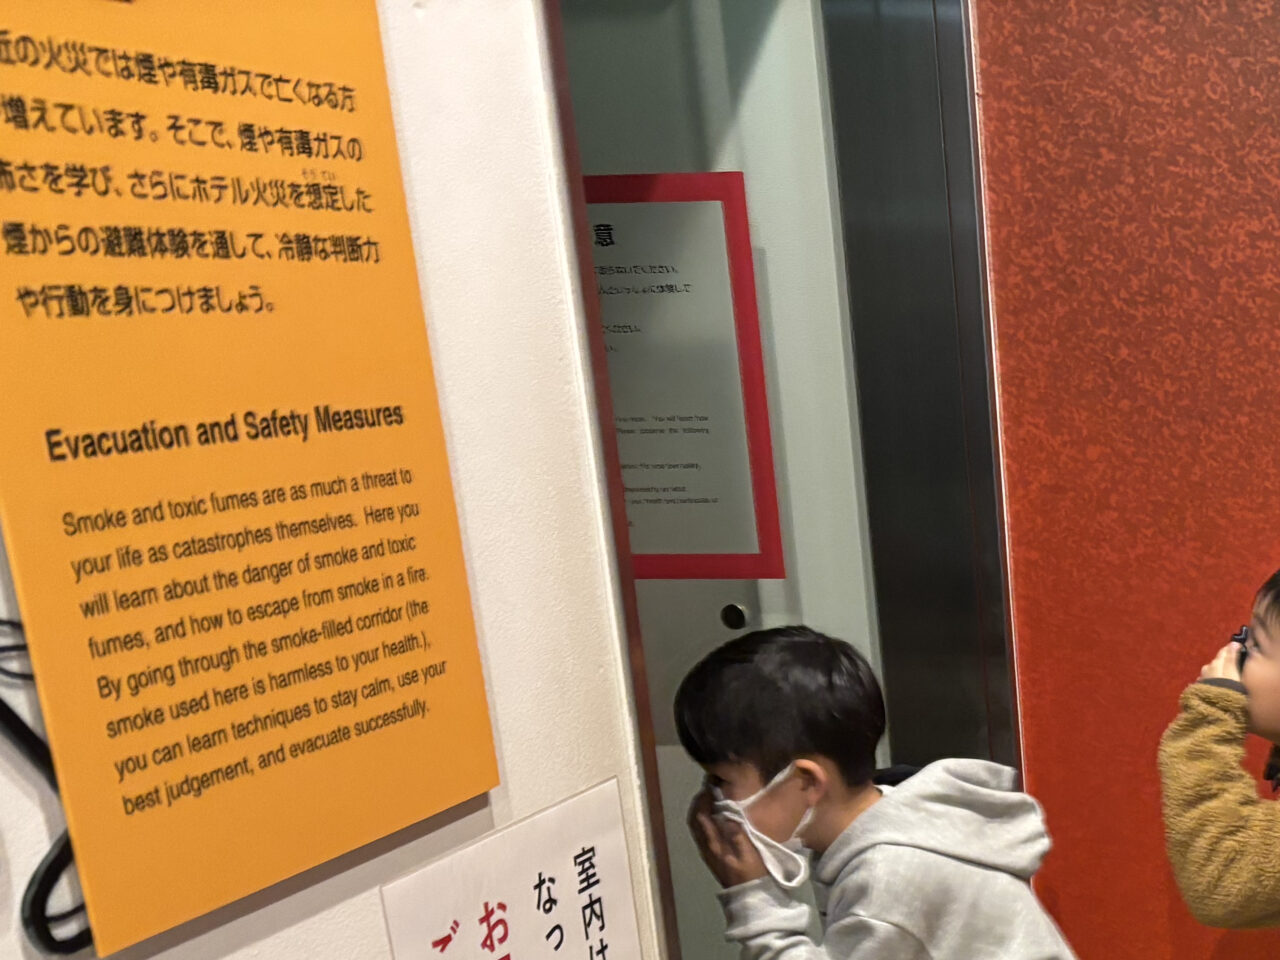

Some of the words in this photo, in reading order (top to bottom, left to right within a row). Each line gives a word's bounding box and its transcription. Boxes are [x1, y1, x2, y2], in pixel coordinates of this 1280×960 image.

[16, 284, 275, 319] や行動を身につけましょう。
[44, 419, 191, 463] Evacuation
[196, 413, 240, 446] and
[243, 409, 310, 443] Safety
[313, 404, 404, 433] Measures
[62, 508, 128, 537] Smoke
[131, 500, 165, 526] and
[167, 496, 208, 520] toxic
[209, 491, 259, 513] fumes
[262, 487, 287, 506] are
[289, 484, 308, 502] as
[310, 476, 347, 498] much
[350, 477, 360, 492] a
[361, 469, 399, 490] threat
[399, 468, 413, 485] to
[70, 553, 112, 584] your
[116, 545, 144, 570] life
[147, 544, 169, 564] as
[172, 526, 274, 559] catastrophes
[275, 513, 358, 541] themselves.
[363, 506, 395, 525] Here
[397, 503, 420, 524] you
[79, 592, 110, 619] will
[112, 587, 159, 611] learn
[163, 574, 211, 602] about
[212, 570, 239, 591] the
[242, 560, 293, 585] danger
[297, 552, 311, 574] of
[314, 546, 359, 570] smoke
[361, 538, 386, 560] and
[387, 534, 416, 555] toxic
[88, 631, 150, 659] fumes,
[154, 617, 187, 644] and
[189, 613, 223, 635] how
[227, 608, 243, 626] to
[246, 596, 300, 622] escape
[302, 588, 334, 608] from
[337, 577, 380, 601] smoke
[381, 573, 394, 590] in
[396, 572, 406, 588] a
[96, 675, 122, 702] By
[126, 664, 176, 697] going
[178, 645, 240, 678] through
[242, 640, 268, 661] the
[271, 616, 354, 654] smoke-filled
[355, 606, 403, 631] corridor
[405, 600, 429, 622] (the
[106, 707, 166, 739] smoke
[169, 690, 211, 720] used
[212, 683, 250, 707] here
[251, 677, 266, 696] is
[267, 660, 334, 692] harmless
[335, 655, 350, 672] to
[351, 647, 379, 672] your
[114, 753, 148, 784] you
[152, 742, 184, 766] can
[186, 728, 228, 754] learn
[231, 702, 312, 740] techniques
[313, 697, 328, 714] to
[331, 688, 358, 709] stay
[361, 677, 395, 700] calm,
[397, 669, 419, 688] use
[421, 661, 447, 685] your
[122, 786, 162, 815] best
[164, 756, 254, 807] judgement,
[257, 743, 286, 770] and
[289, 726, 351, 759] evacuate
[353, 698, 429, 737] successfully.
